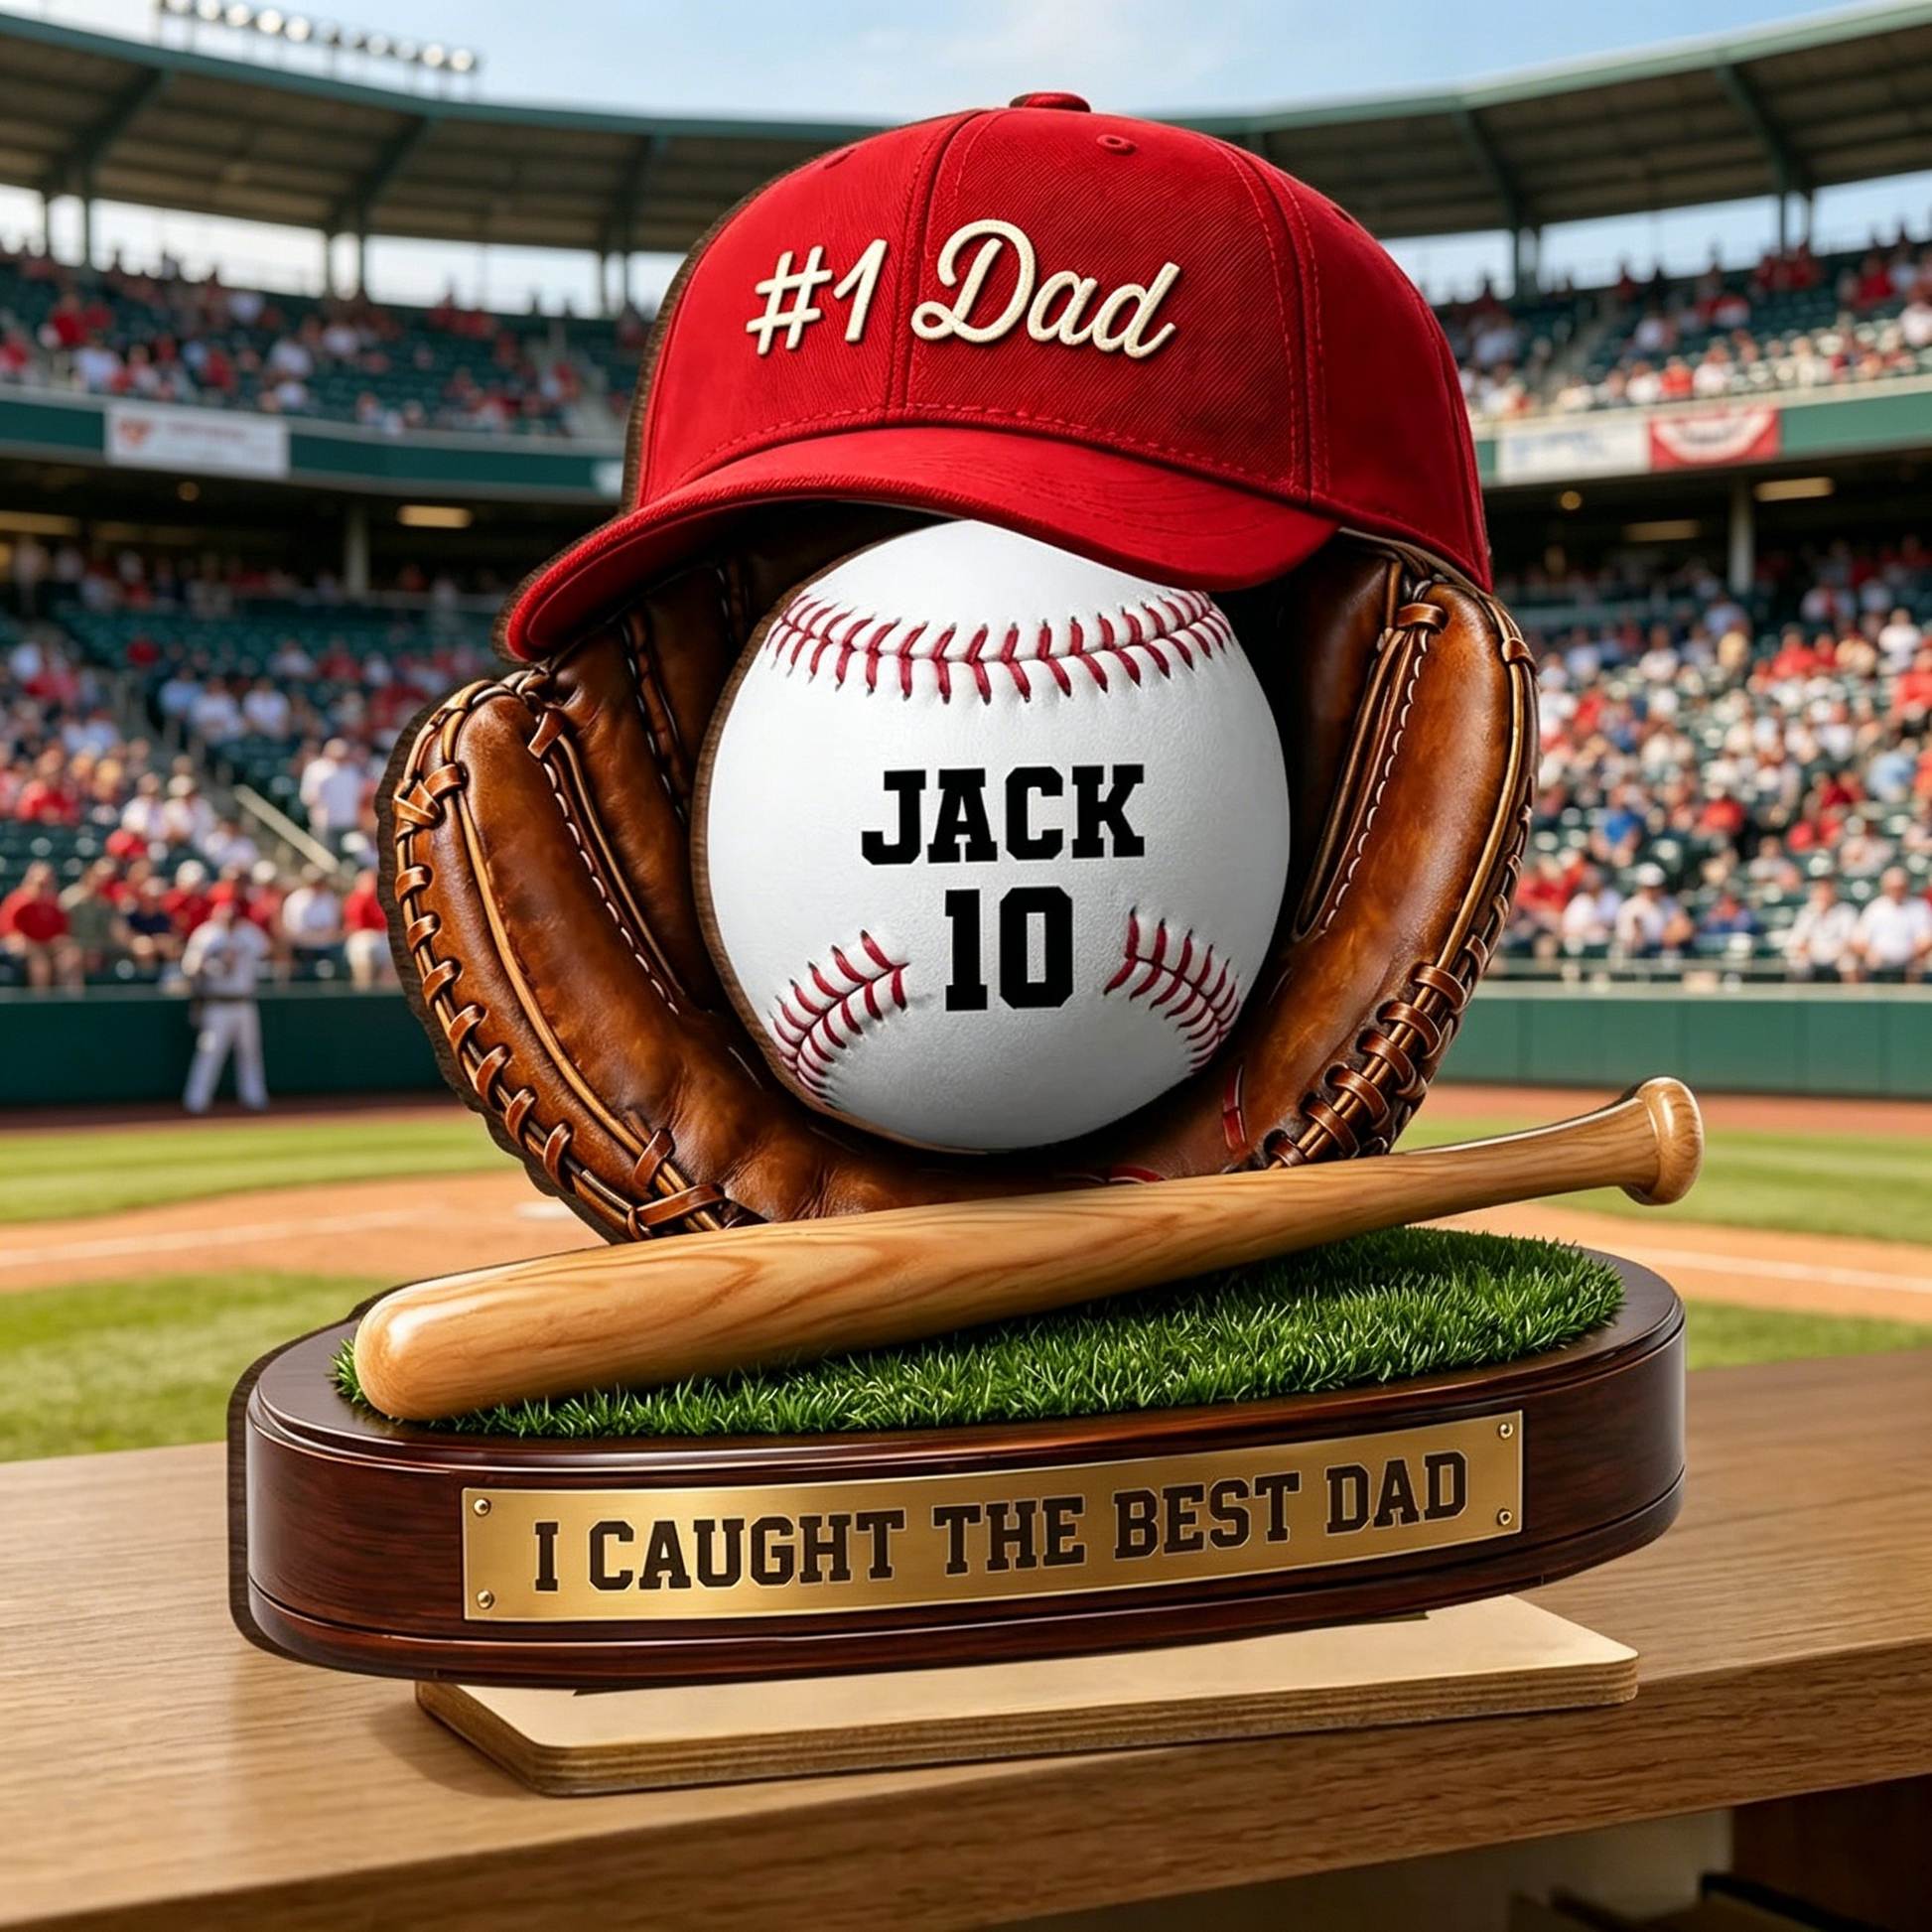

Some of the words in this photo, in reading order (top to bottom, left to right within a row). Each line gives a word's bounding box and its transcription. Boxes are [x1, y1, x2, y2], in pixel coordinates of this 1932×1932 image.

[746, 239, 888, 355] #1
[910, 218, 1180, 358] Dad
[861, 763, 1145, 866] JACK
[945, 886, 1073, 1012] 10
[534, 1521, 559, 1591] I
[589, 1509, 905, 1590] CAUGHT
[932, 1495, 1085, 1576] THE
[1113, 1470, 1300, 1560] BEST
[1325, 1450, 1467, 1535] DAD
